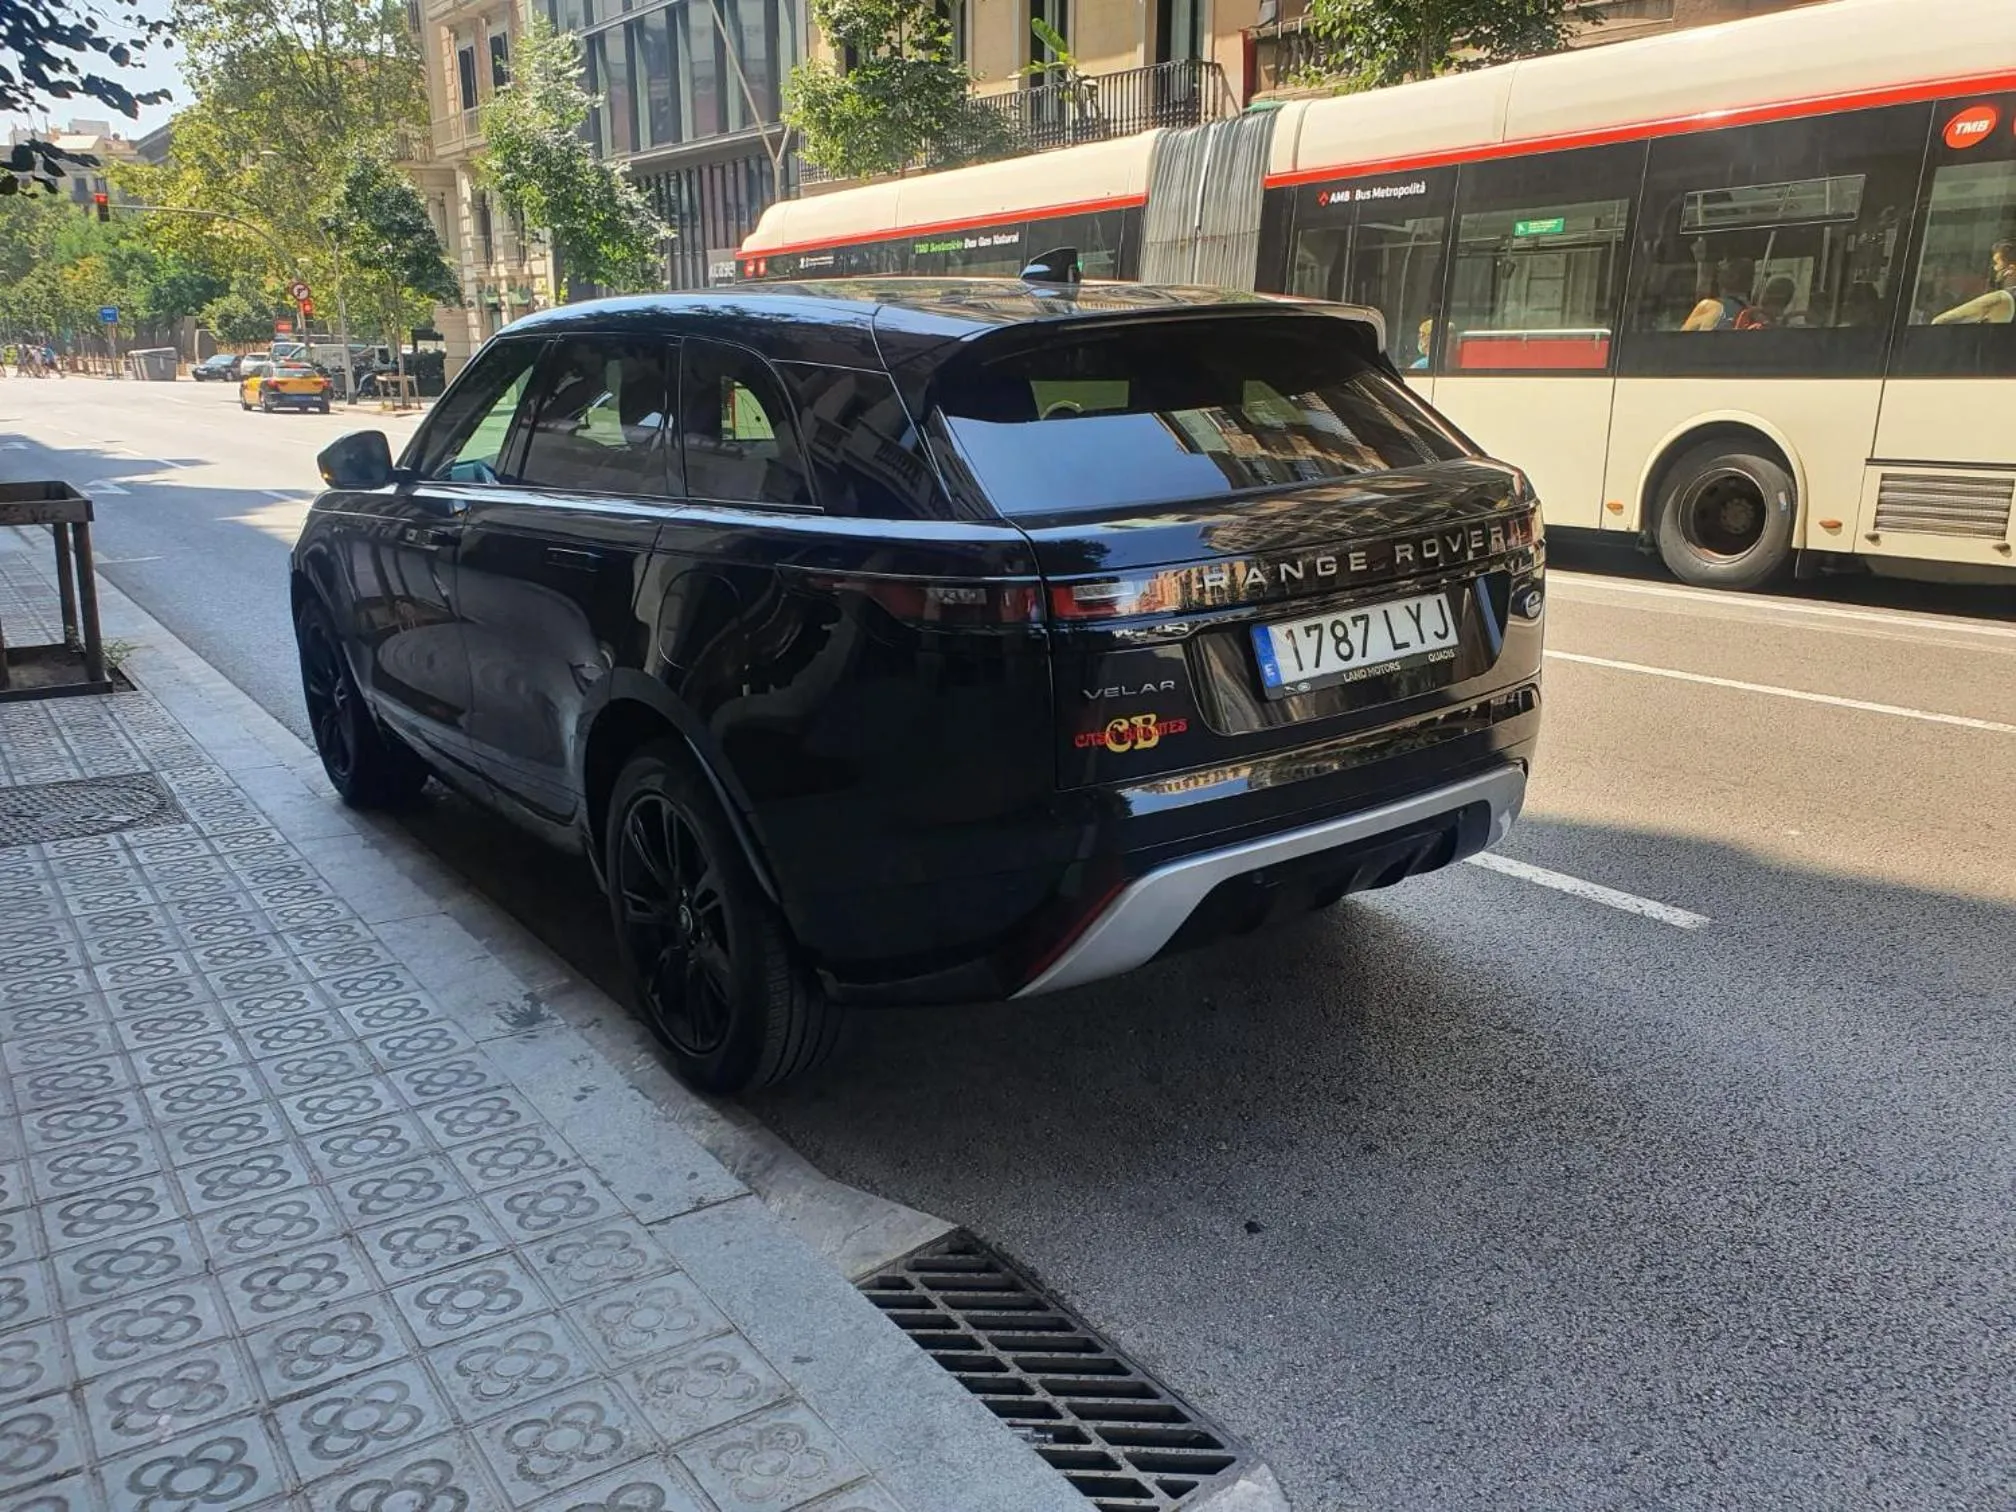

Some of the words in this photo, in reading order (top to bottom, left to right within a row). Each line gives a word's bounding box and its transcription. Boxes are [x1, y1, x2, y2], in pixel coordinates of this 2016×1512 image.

[1955, 120, 1989, 135] TMB
[1330, 191, 1350, 203] AMB
[1355, 189, 1371, 201] Bus
[1203, 551, 1368, 592] RANGE
[1395, 527, 1506, 564] ROVER
[1285, 613, 1370, 672] 1787
[1383, 599, 1450, 651] LYJ
[1343, 668, 1366, 682] LAND
[1367, 661, 1400, 678] MOTORS
[1083, 680, 1175, 699] VELAR
